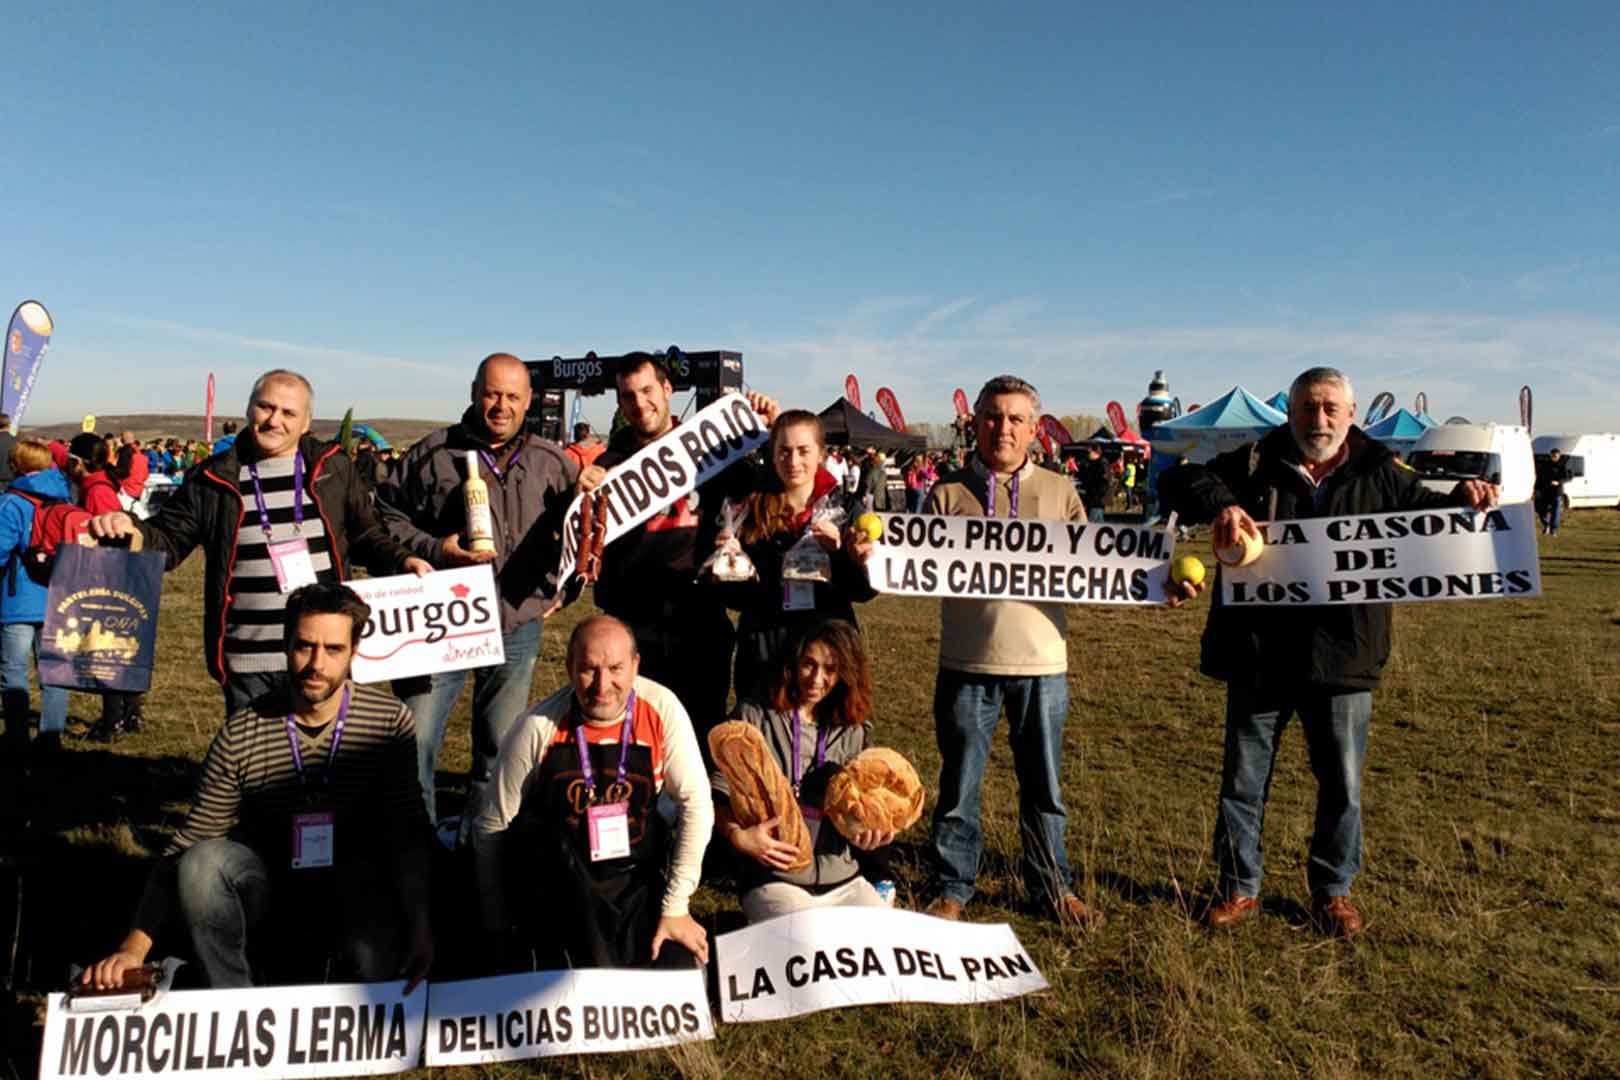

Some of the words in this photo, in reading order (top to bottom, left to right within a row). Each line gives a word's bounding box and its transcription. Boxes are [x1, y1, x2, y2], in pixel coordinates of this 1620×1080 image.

[553, 360, 602, 384] Burgos
[559, 446, 687, 575] TIDOS
[679, 399, 760, 473] ROJO
[965, 520, 1053, 553] PROD.
[1066, 524, 1086, 555] Y
[1094, 526, 1170, 560] COM.
[1262, 523, 1309, 545] LA
[1326, 510, 1512, 542] CASONA
[885, 558, 938, 592] LAS
[947, 560, 1148, 602] CADERECHAS
[1334, 547, 1397, 571] DE
[1231, 581, 1311, 603] LOS
[1326, 570, 1532, 601] PISONES
[728, 966, 776, 1001] LA
[785, 947, 886, 988] CASA
[892, 946, 957, 981] DEL
[961, 954, 1032, 982] PAN
[58, 1007, 276, 1077] MORCILLAS
[287, 1003, 407, 1065] LERMA
[439, 1005, 573, 1053] DELICIAS
[582, 1002, 699, 1040] BURGOS
